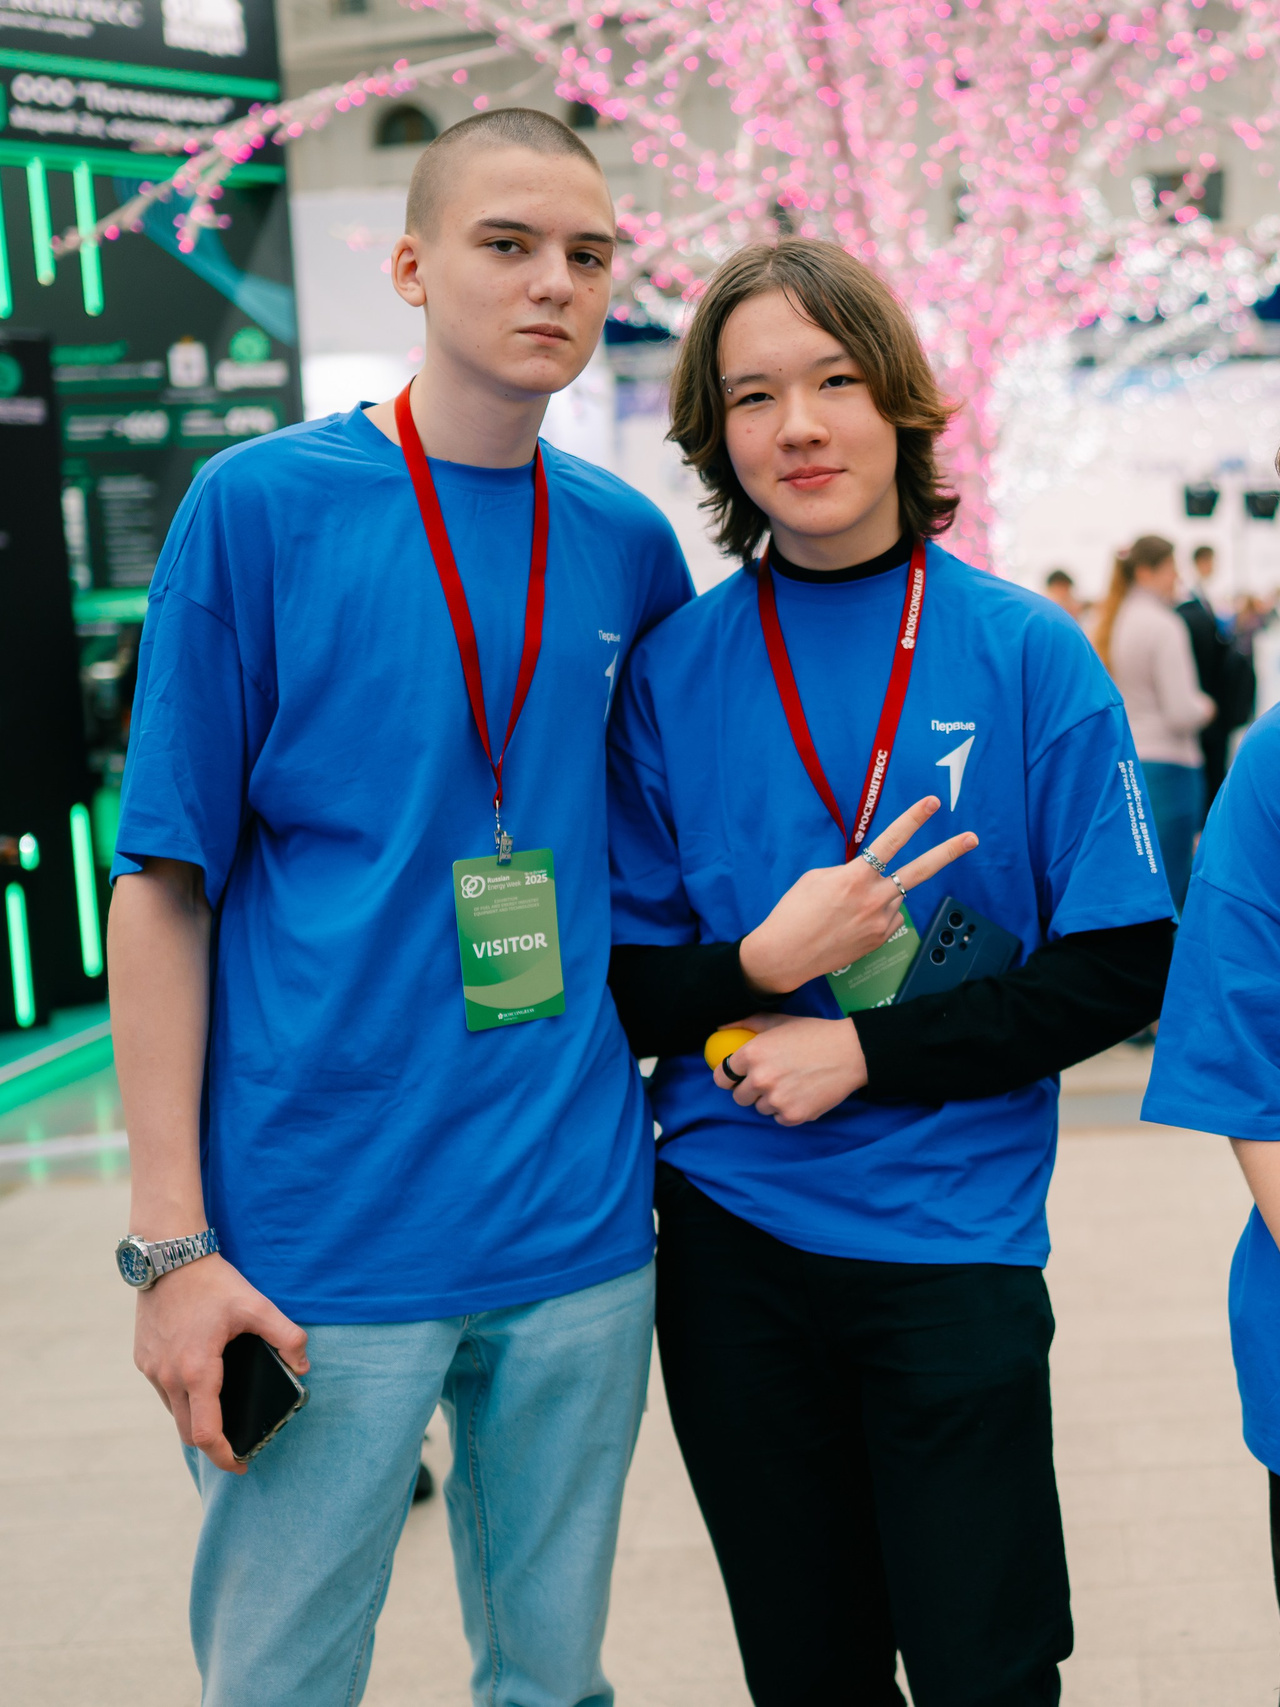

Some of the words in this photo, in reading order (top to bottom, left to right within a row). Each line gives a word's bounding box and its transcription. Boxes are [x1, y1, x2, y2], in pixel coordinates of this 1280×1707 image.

[905, 568, 924, 638] ROSCONGRESS
[931, 719, 976, 734] Первые
[859, 749, 889, 832] РОСКОНГРЕСС
[1139, 822, 1158, 874] движение
[487, 875, 510, 884] Russian
[506, 880, 521, 888] Week
[525, 873, 548, 885] 2025
[473, 932, 548, 959] VISITOR
